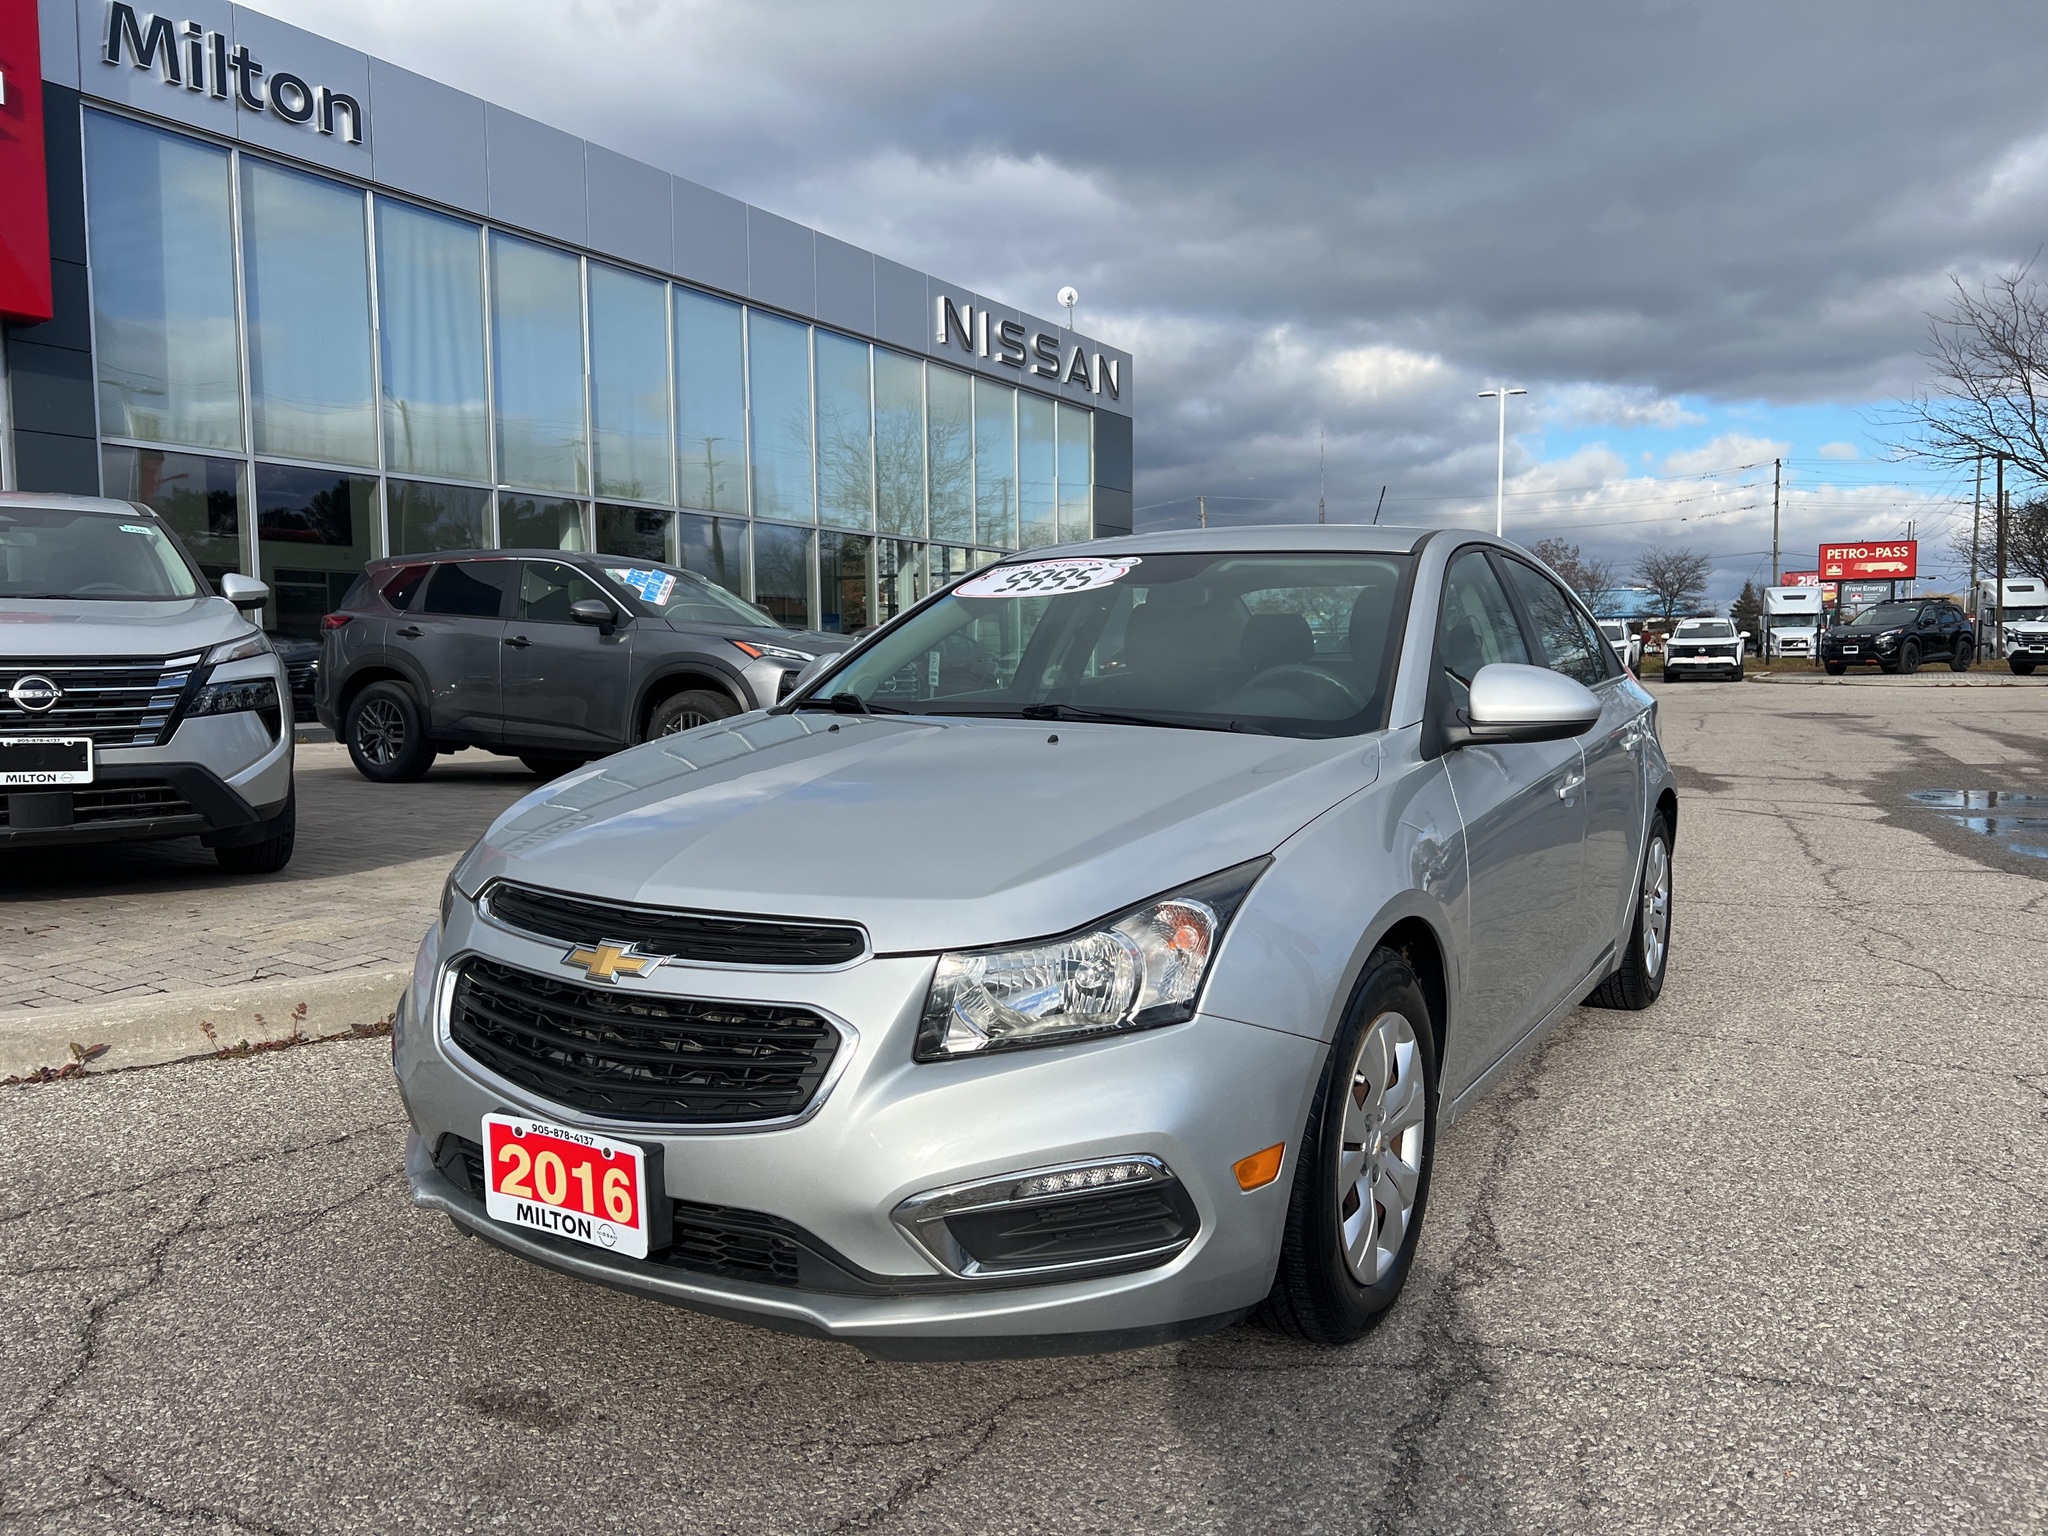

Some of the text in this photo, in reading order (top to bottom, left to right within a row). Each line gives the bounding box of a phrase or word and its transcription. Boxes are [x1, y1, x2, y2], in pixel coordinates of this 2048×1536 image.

[103, 0, 363, 145] Milton
[936, 294, 1121, 399] NISSAN
[1826, 546, 1909, 560] PETRO-PASS
[1863, 584, 1888, 593] Energy
[5, 774, 57, 783] MILTON
[531, 1123, 594, 1146] 905-878-4137
[498, 1143, 633, 1223] 2016
[516, 1203, 592, 1240] MILTON
